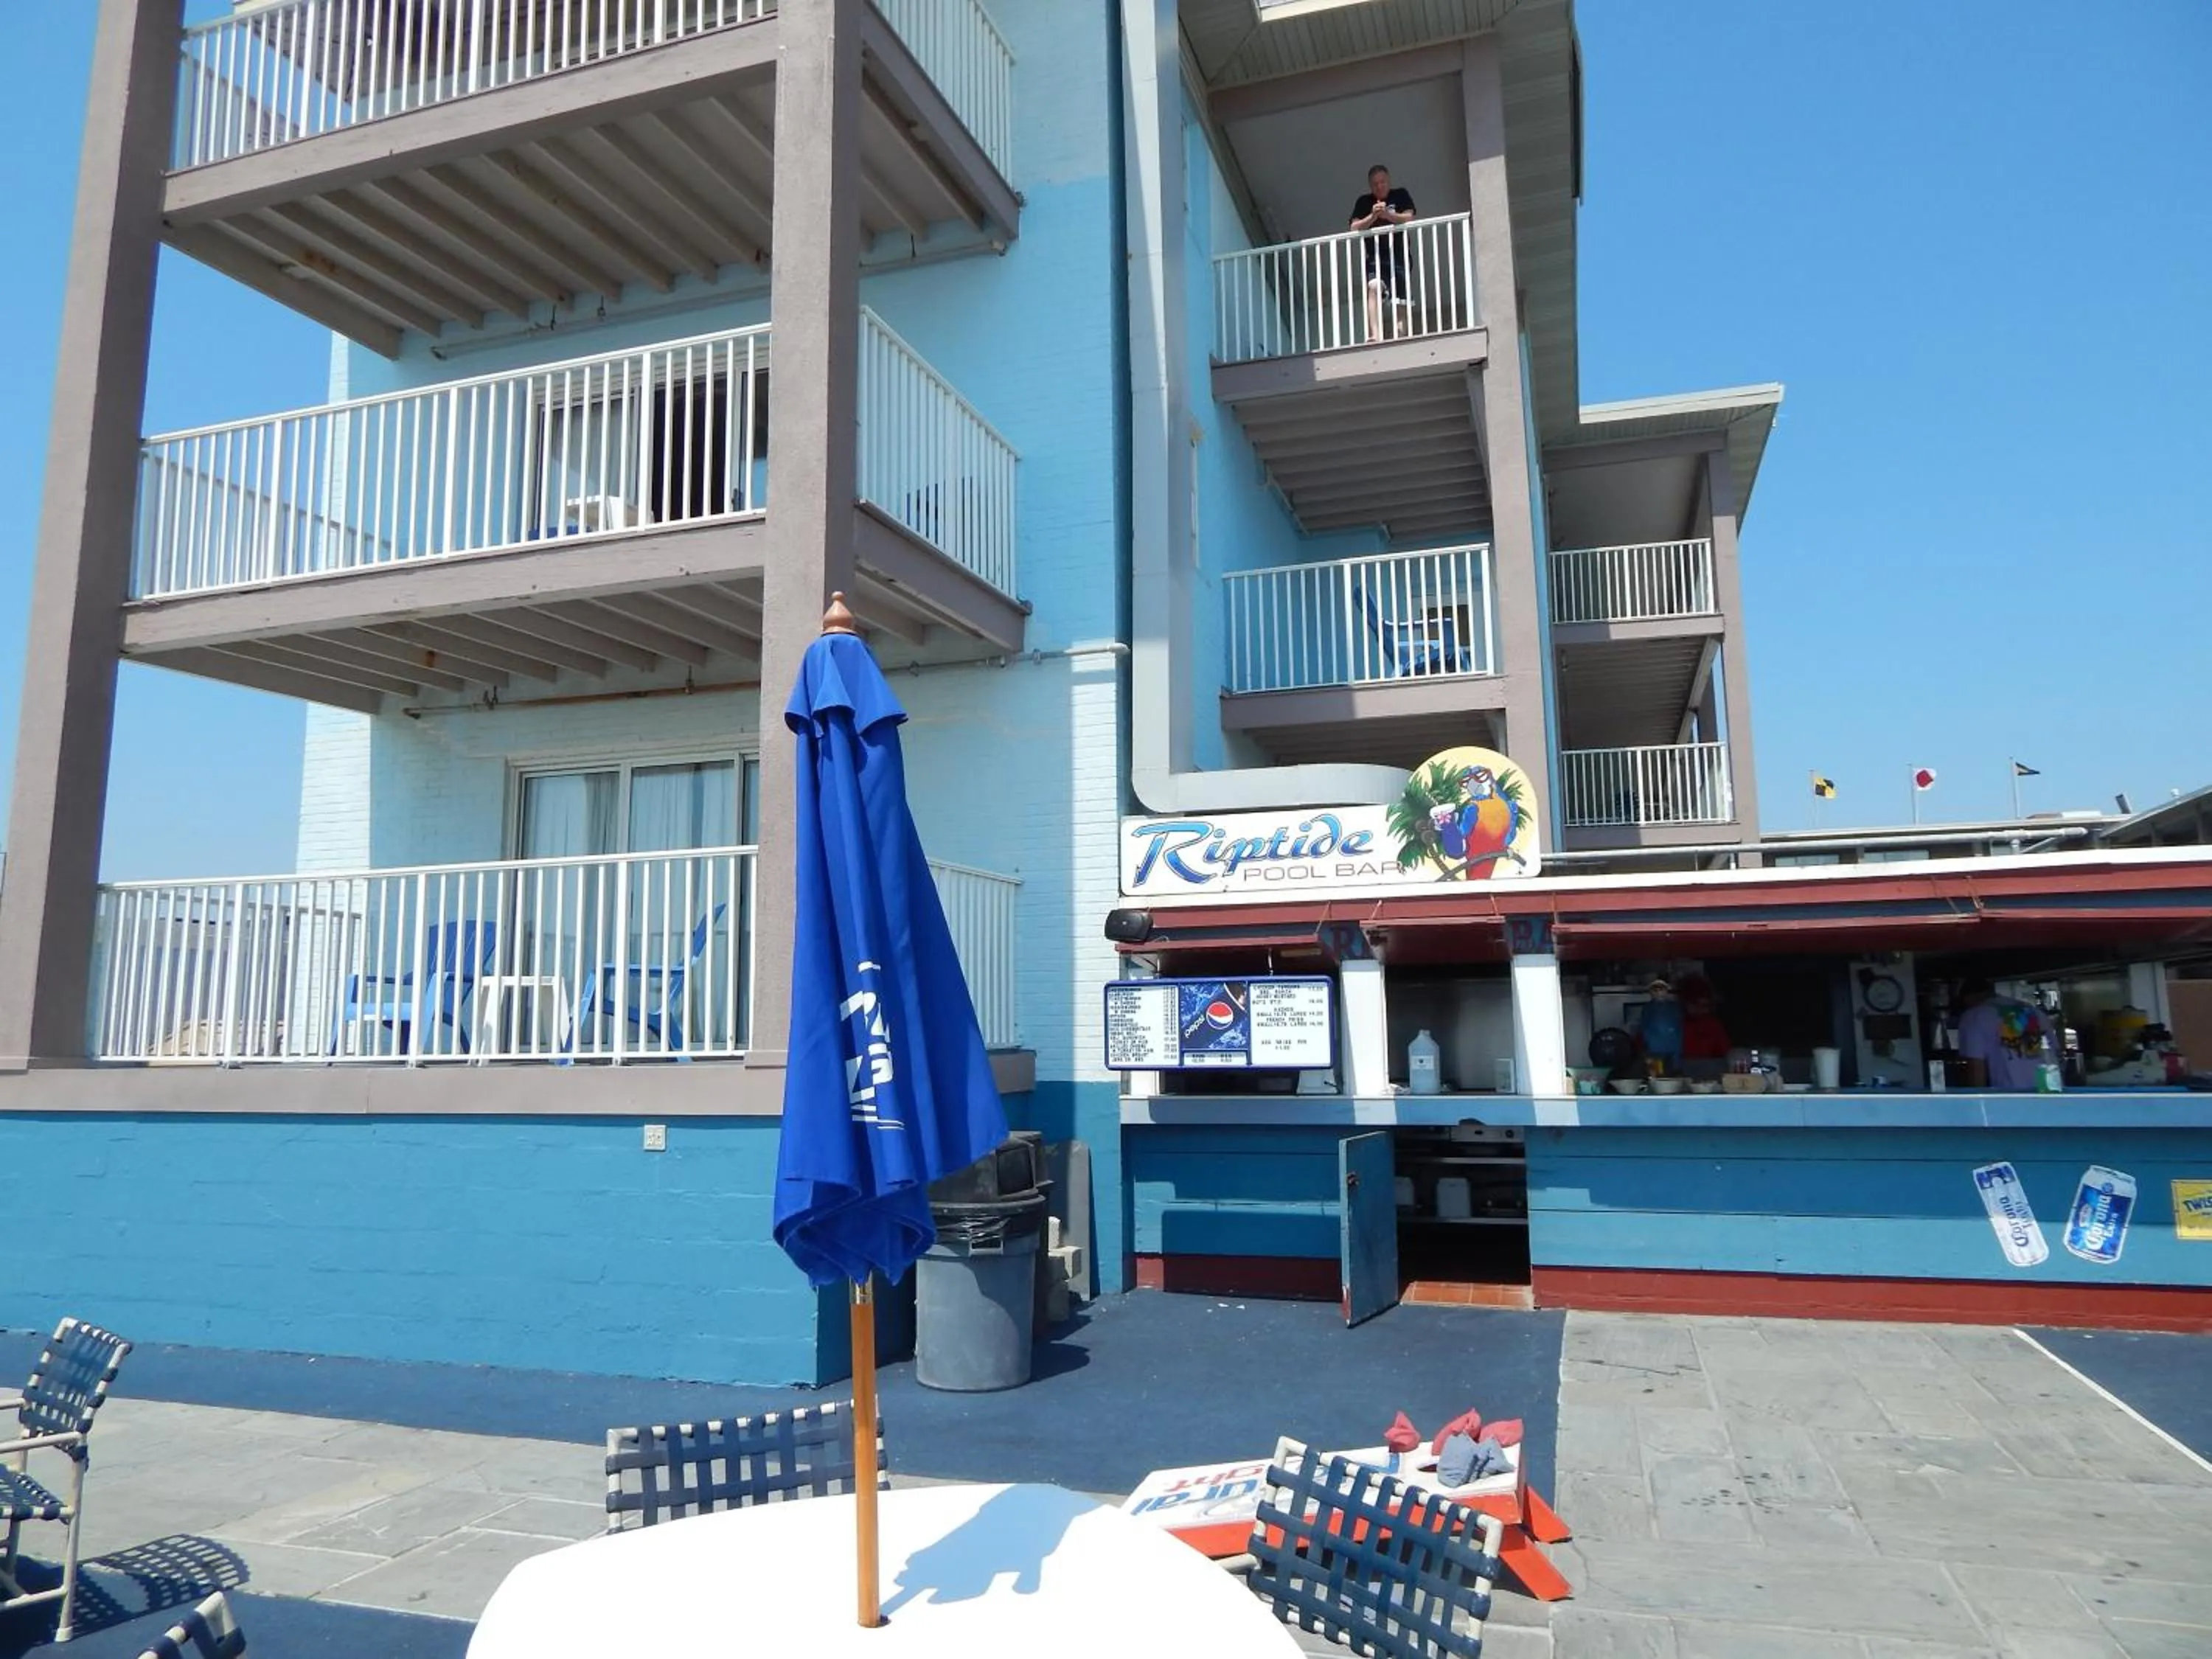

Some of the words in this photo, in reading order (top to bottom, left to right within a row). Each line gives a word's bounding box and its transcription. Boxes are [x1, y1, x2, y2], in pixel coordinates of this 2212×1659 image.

[1132, 813, 1374, 888] Riptide
[1243, 863, 1326, 883] POOL
[1335, 860, 1405, 877] BAR
[1999, 1195, 2029, 1248] Corona
[2082, 1193, 2112, 1251] Corona
